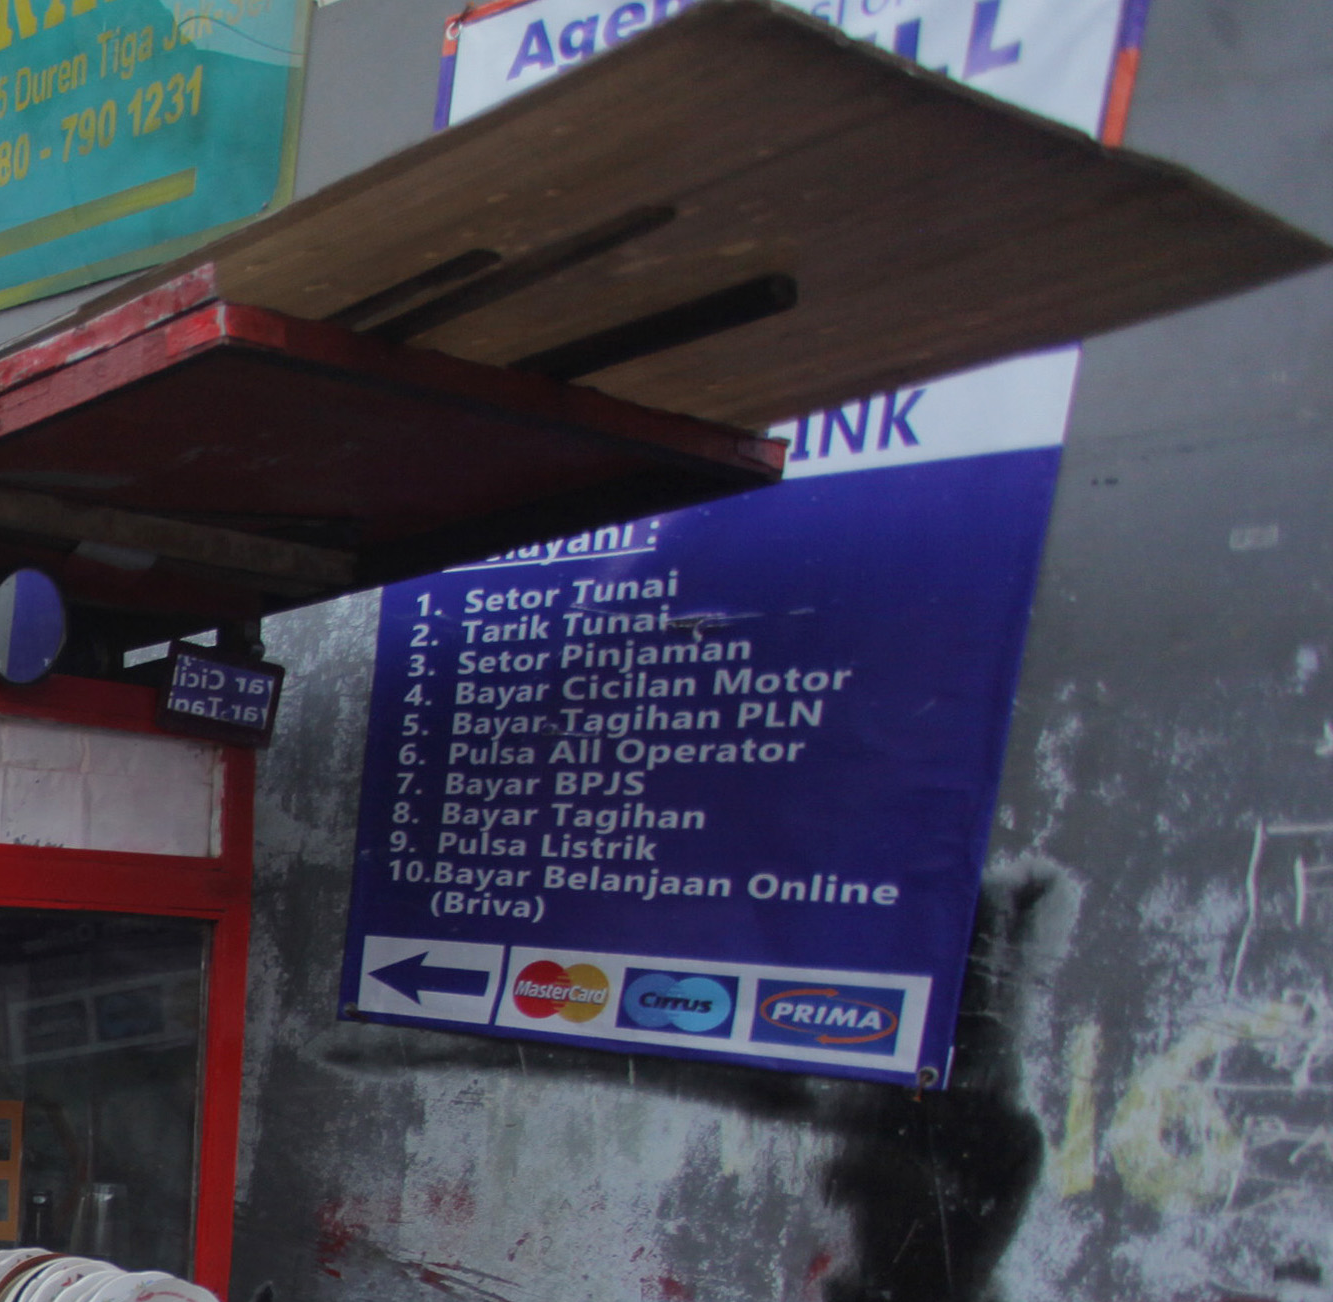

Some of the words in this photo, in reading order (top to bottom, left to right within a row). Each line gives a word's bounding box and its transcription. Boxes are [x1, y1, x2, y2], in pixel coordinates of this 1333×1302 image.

[14, 52, 88, 112] Duren
[97, 25, 154, 80] Tiga
[60, 99, 117, 163] 790
[127, 64, 204, 137] 1231
[416, 592, 444, 618] 1.
[464, 589, 561, 614] Setor
[573, 569, 680, 604] Tunai
[409, 624, 439, 648] 2.
[461, 614, 550, 644] Tarik
[564, 604, 671, 637] Tunai
[407, 654, 435, 677] 3.
[457, 651, 550, 676] Setor
[560, 639, 752, 674] Pinjaman
[403, 684, 432, 707] 4.
[455, 681, 550, 711] Bayar
[561, 671, 697, 701] Cicilan
[712, 667, 853, 696] Motor
[401, 713, 429, 737] 5.
[451, 710, 547, 741] Bayar
[559, 704, 721, 738] Tagihan
[736, 699, 824, 729] PLN
[398, 742, 426, 766] 6.
[448, 739, 535, 766] Pulsa
[547, 738, 602, 765] All
[615, 737, 806, 771] Operator
[396, 772, 423, 796] 7.
[444, 772, 541, 802] Bayar
[553, 771, 646, 796] BPJS
[391, 802, 419, 825] 8.
[441, 801, 539, 832] Bayar
[550, 802, 707, 835] Tagihan
[389, 830, 416, 854] 9.
[437, 831, 528, 857] Pulsa
[540, 833, 658, 862] Listrik
[543, 865, 733, 902] Belanjaan
[746, 872, 901, 906] Online
[429, 890, 546, 924] (Briva)
[514, 978, 609, 1006] MasterCard
[638, 989, 713, 1015] Cirrus
[770, 1000, 883, 1032] PRIMA
